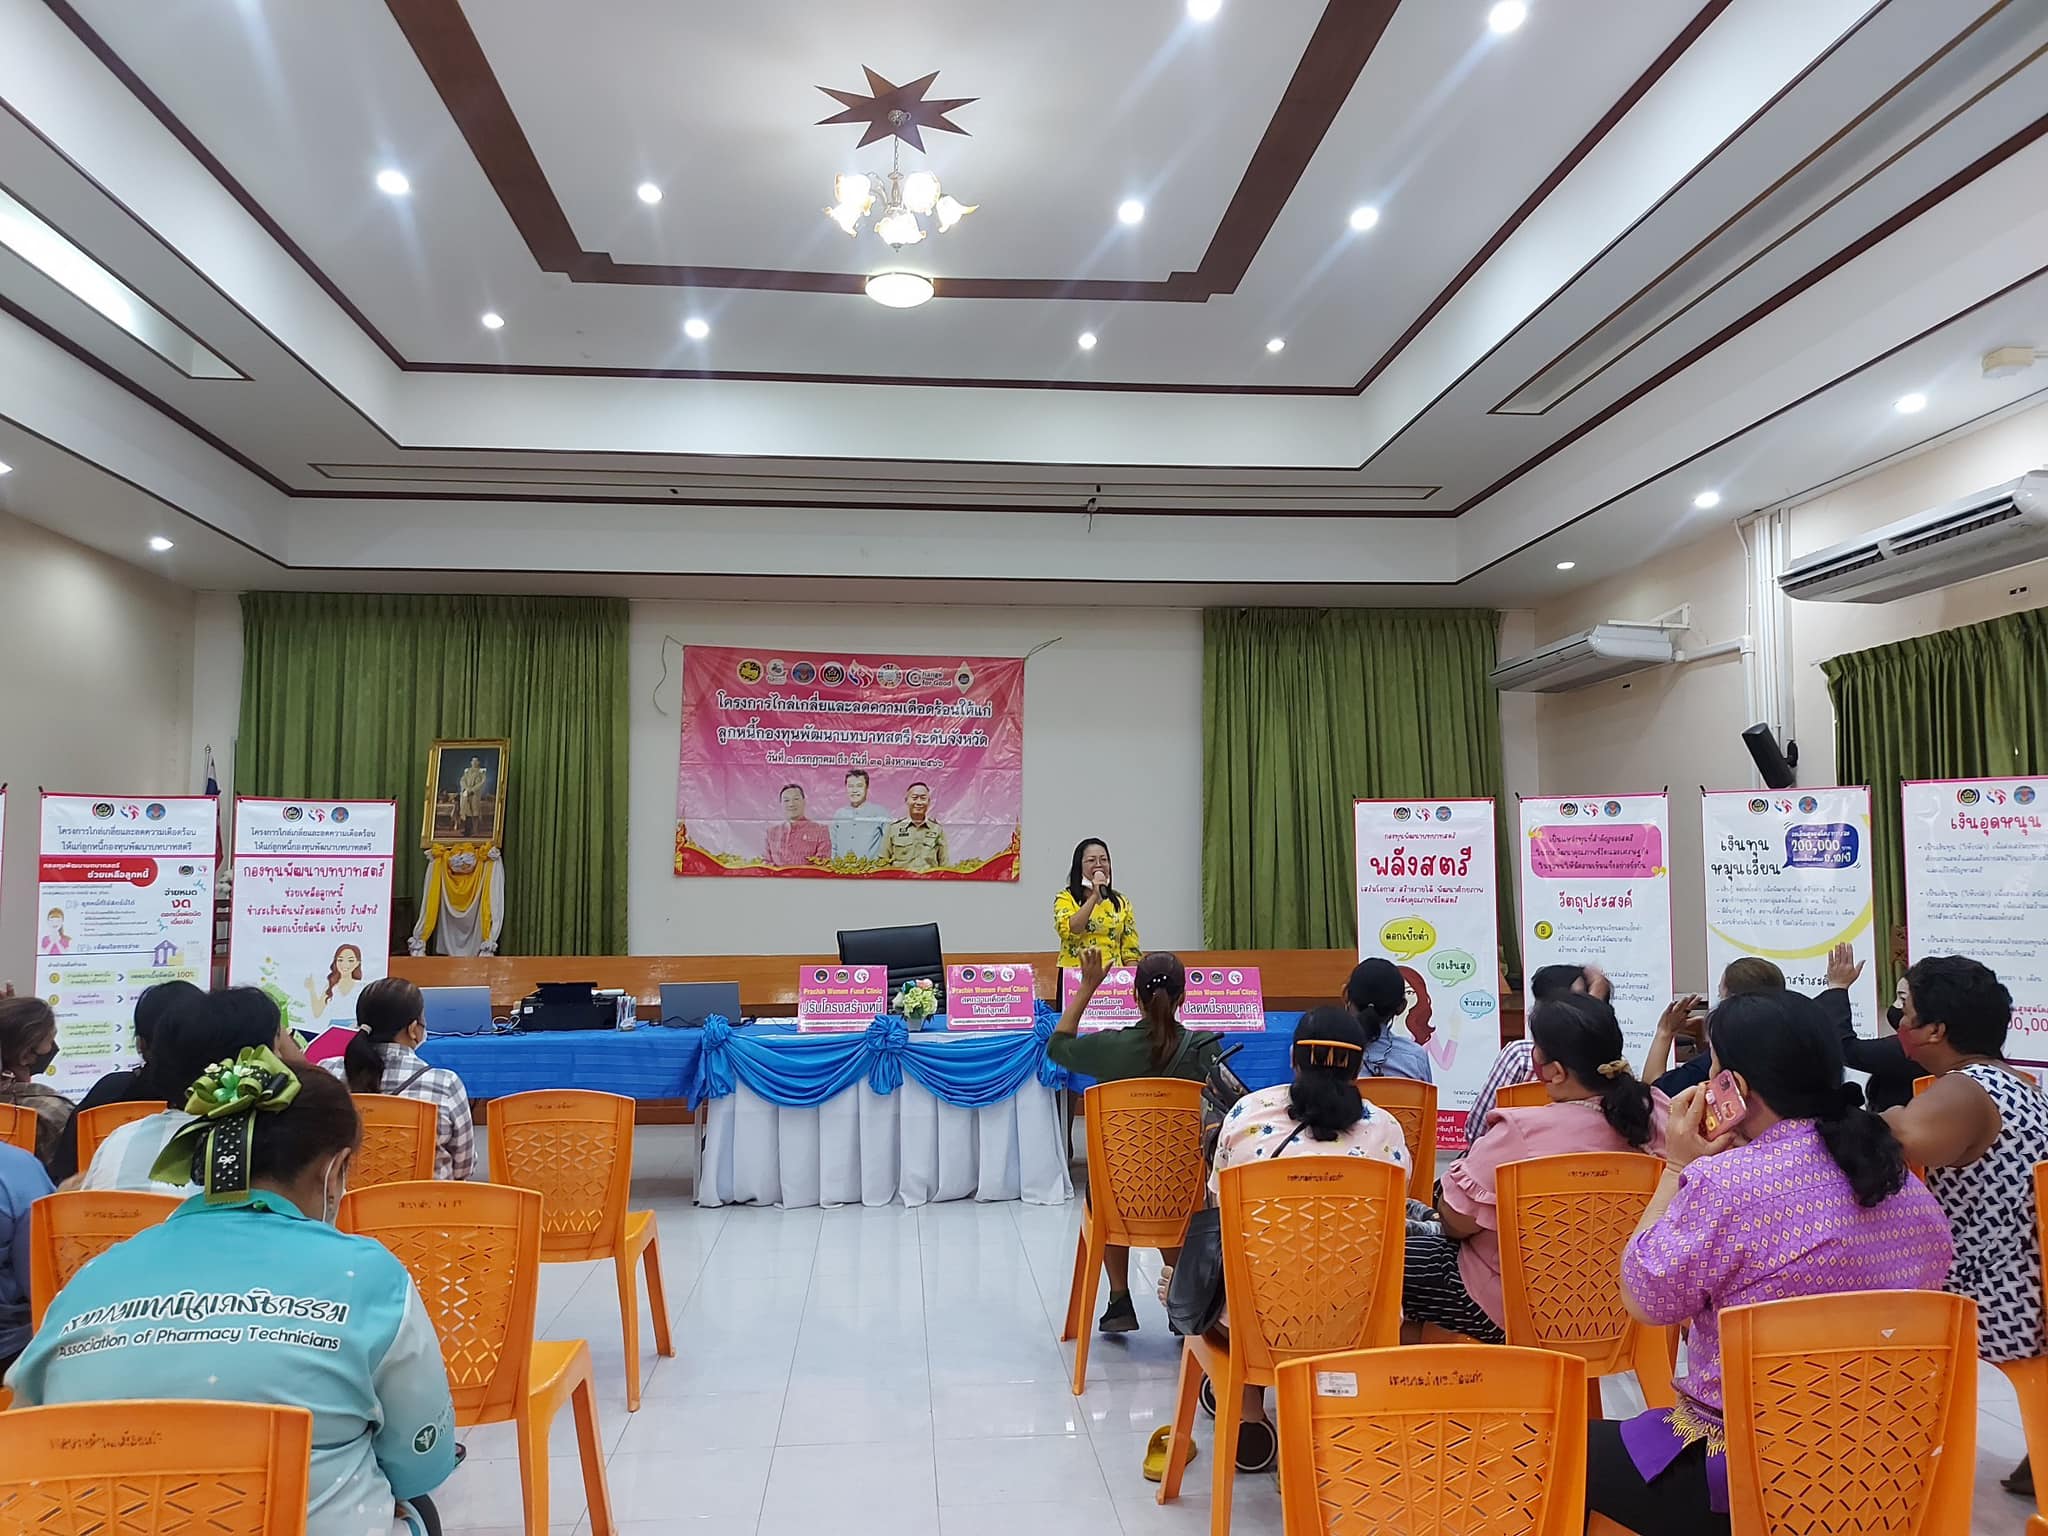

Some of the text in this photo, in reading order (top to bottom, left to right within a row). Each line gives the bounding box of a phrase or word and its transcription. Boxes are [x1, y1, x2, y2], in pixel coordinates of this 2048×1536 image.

[718, 691, 992, 718] โครงการไกล่เกลี่ยและลดความเดือดร้อนให้แก่
[718, 719, 988, 748] ลูกหนี้กองทุนพัฒนาบทบาทสตรี ระดับจังหวัด
[1951, 811, 2042, 836] เงินอุดหนุน
[1721, 834, 1770, 858] เงินทุน
[1791, 839, 1840, 855] 200,000
[243, 862, 385, 882] กองทุนพัฒนาบทบาทสตรี
[1370, 846, 1472, 876] พลังสตรี
[1710, 859, 1781, 881] หมุนเวียน
[1559, 889, 1633, 915] วัตถุประสงค์
[802, 996, 883, 1014] ปรับโครงสร้างหนี้
[1183, 996, 1259, 1018] ปลดหนี้รายบุคคล
[58, 1327, 339, 1358] Association of Pharmacy Technicians
